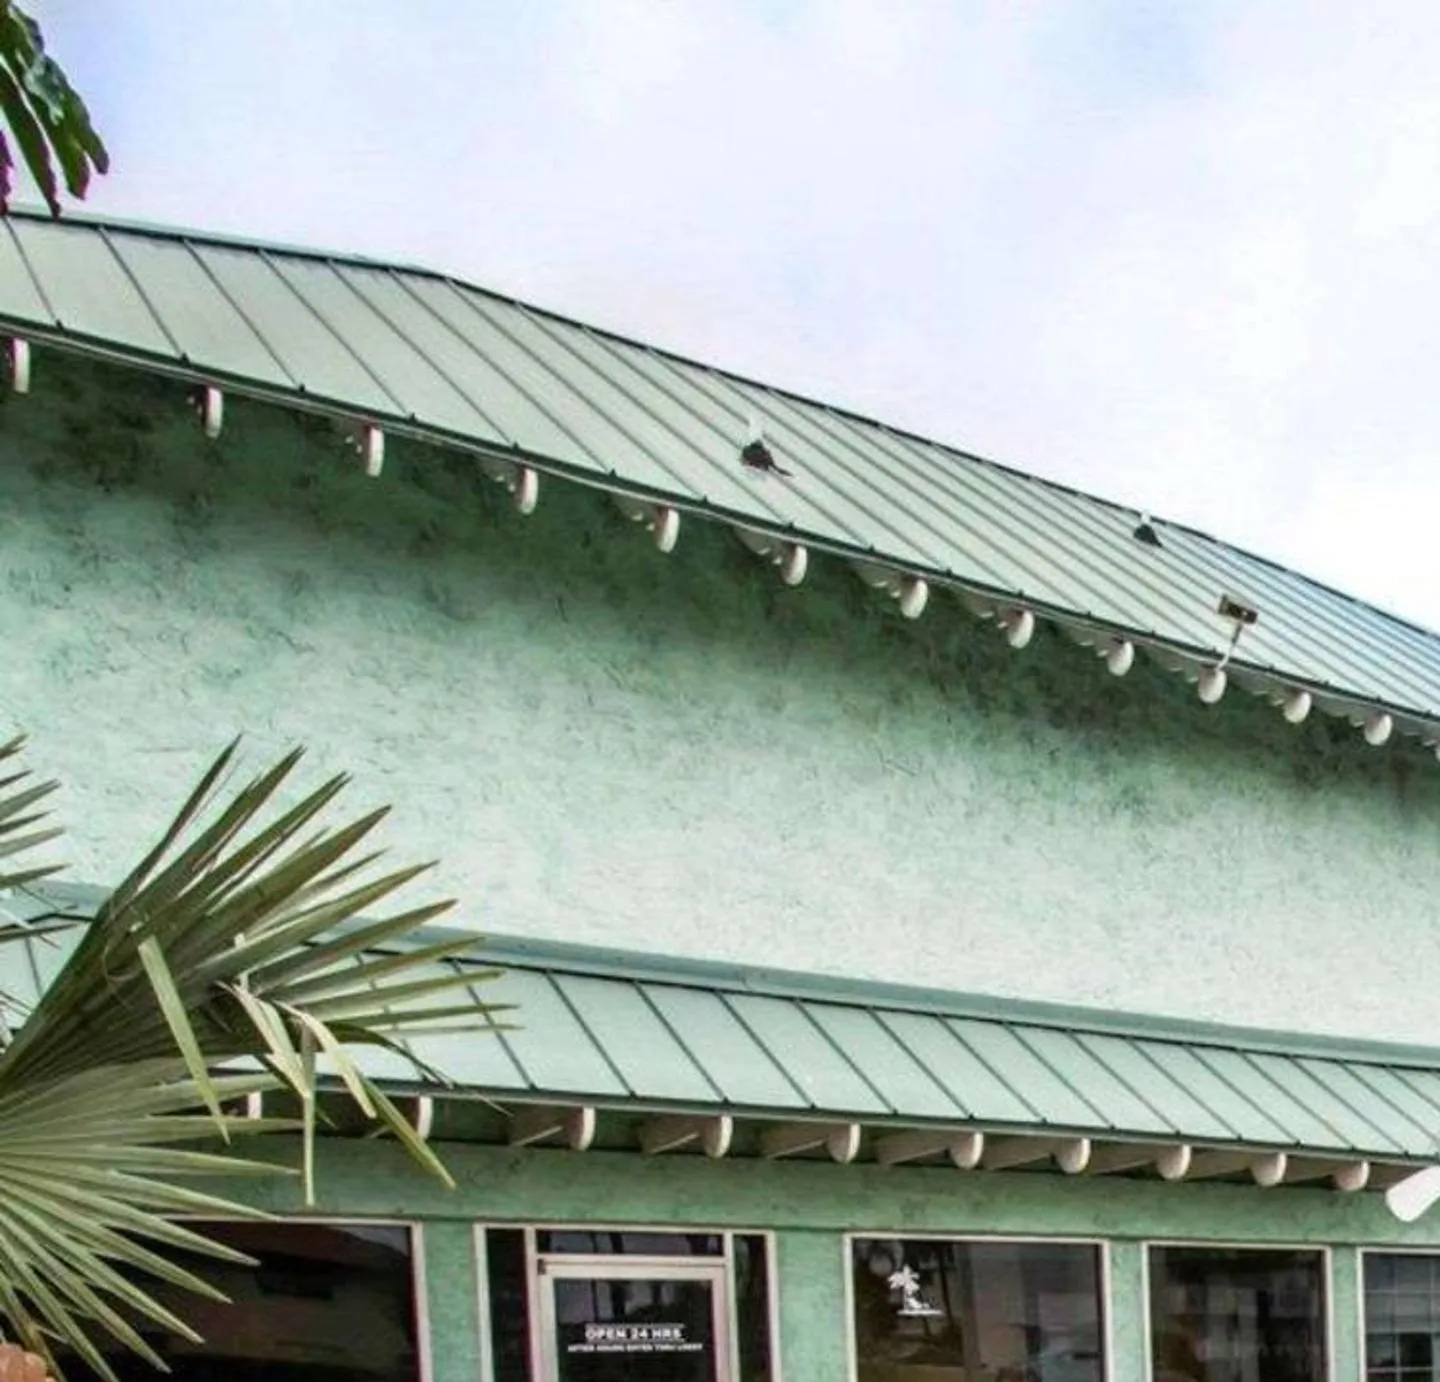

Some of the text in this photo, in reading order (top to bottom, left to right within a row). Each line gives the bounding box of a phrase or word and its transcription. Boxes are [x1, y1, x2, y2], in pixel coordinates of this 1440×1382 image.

[585, 1327, 683, 1340] OPEN 24 HRS
